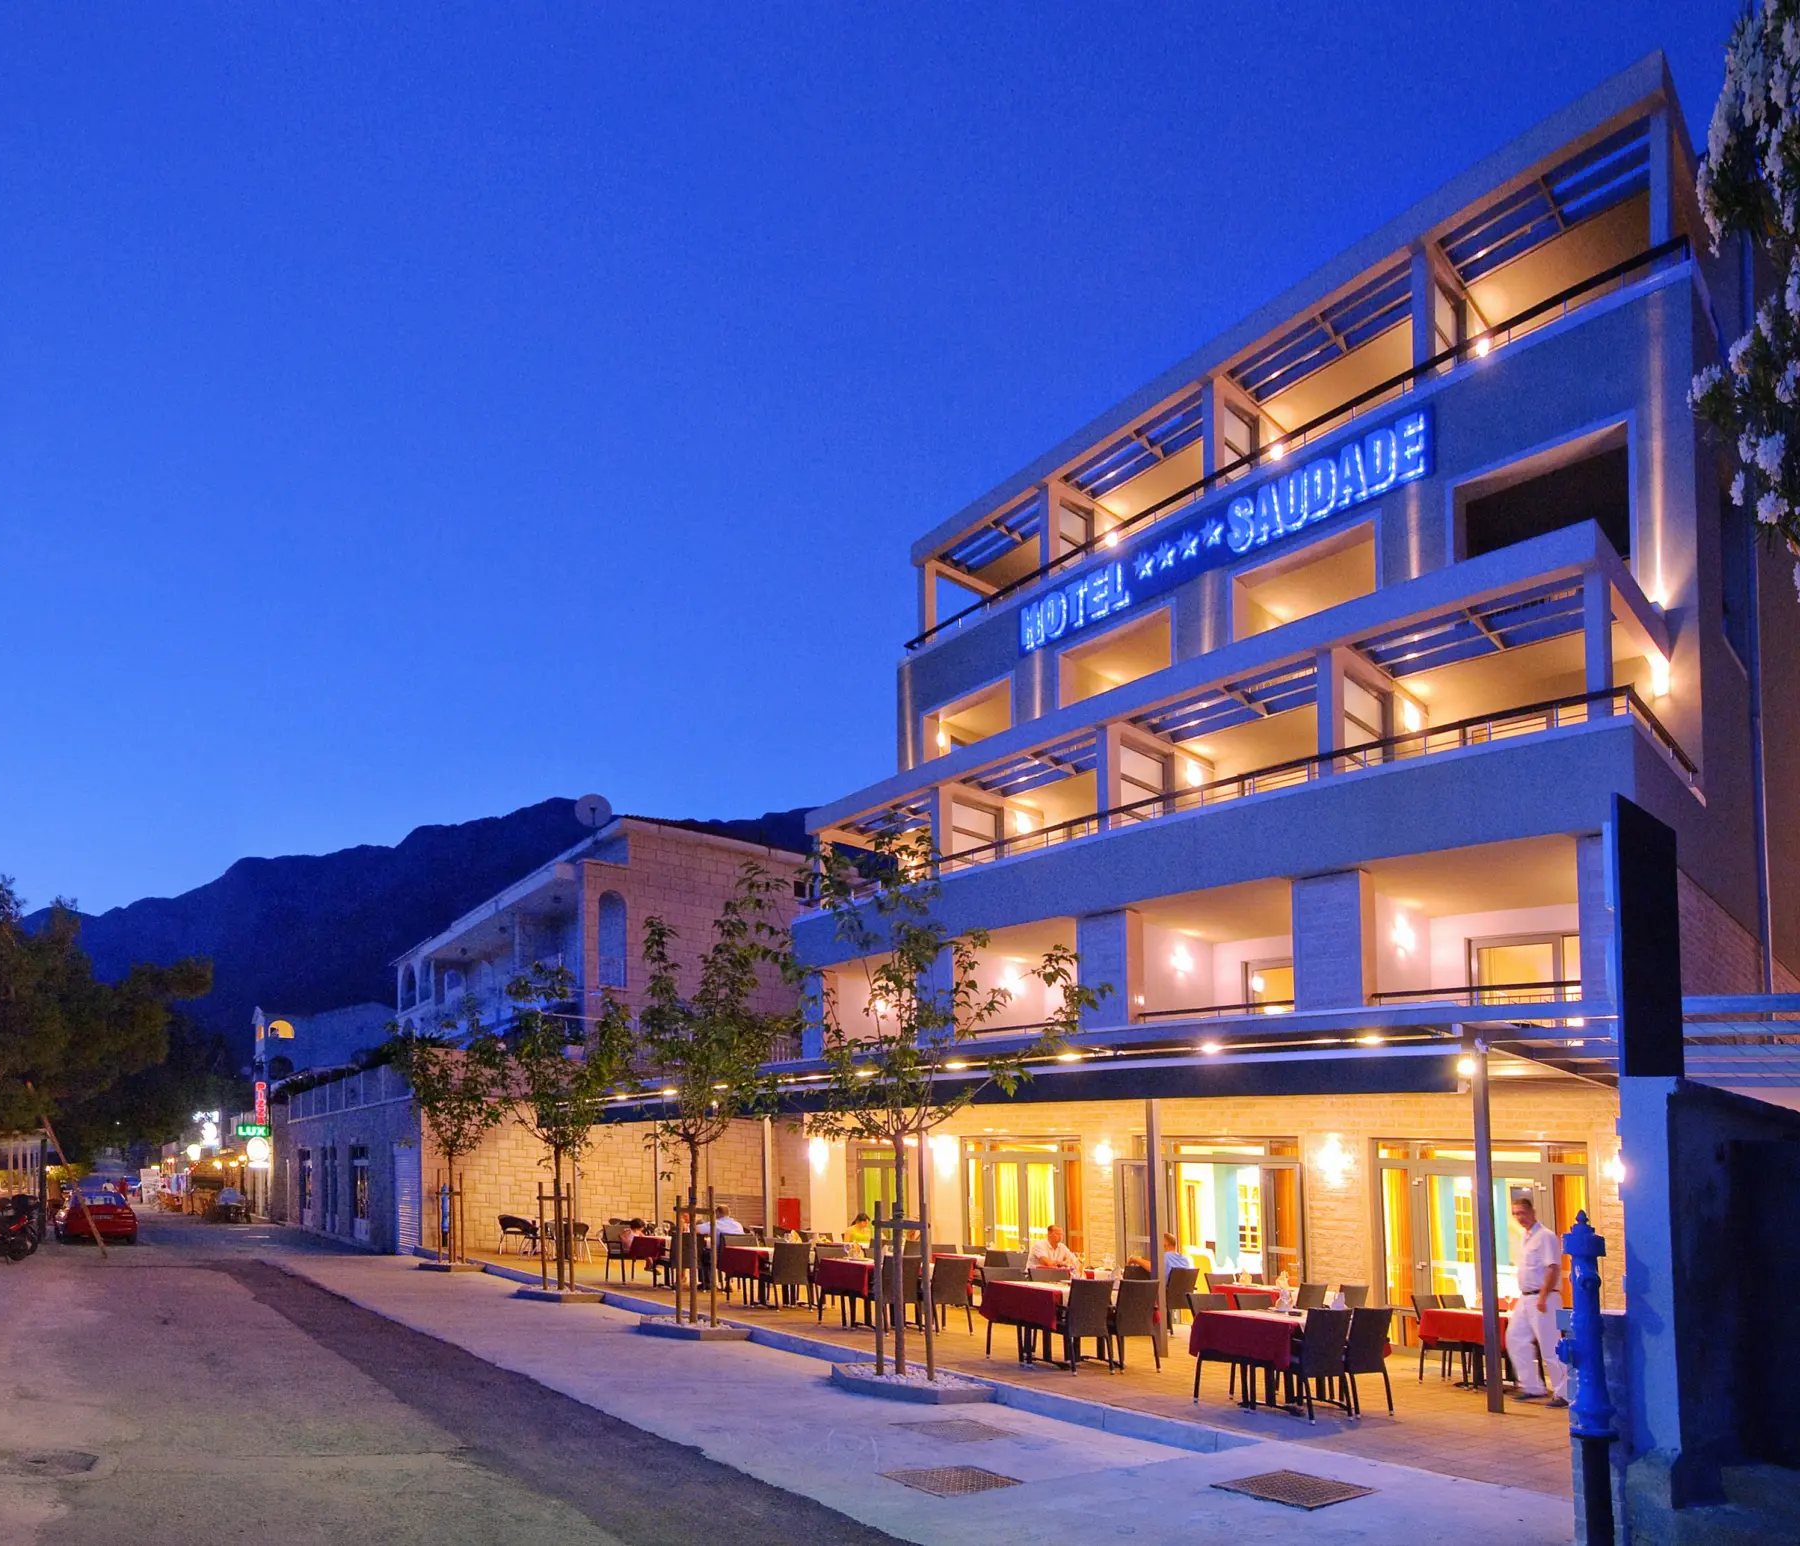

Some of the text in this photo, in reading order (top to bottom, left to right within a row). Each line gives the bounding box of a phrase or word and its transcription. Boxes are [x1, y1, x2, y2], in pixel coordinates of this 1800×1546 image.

[1020, 412, 1425, 650] HOTEL SAUDADE
[256, 1082, 266, 1125] PIZZA
[238, 1127, 266, 1136] LUX
